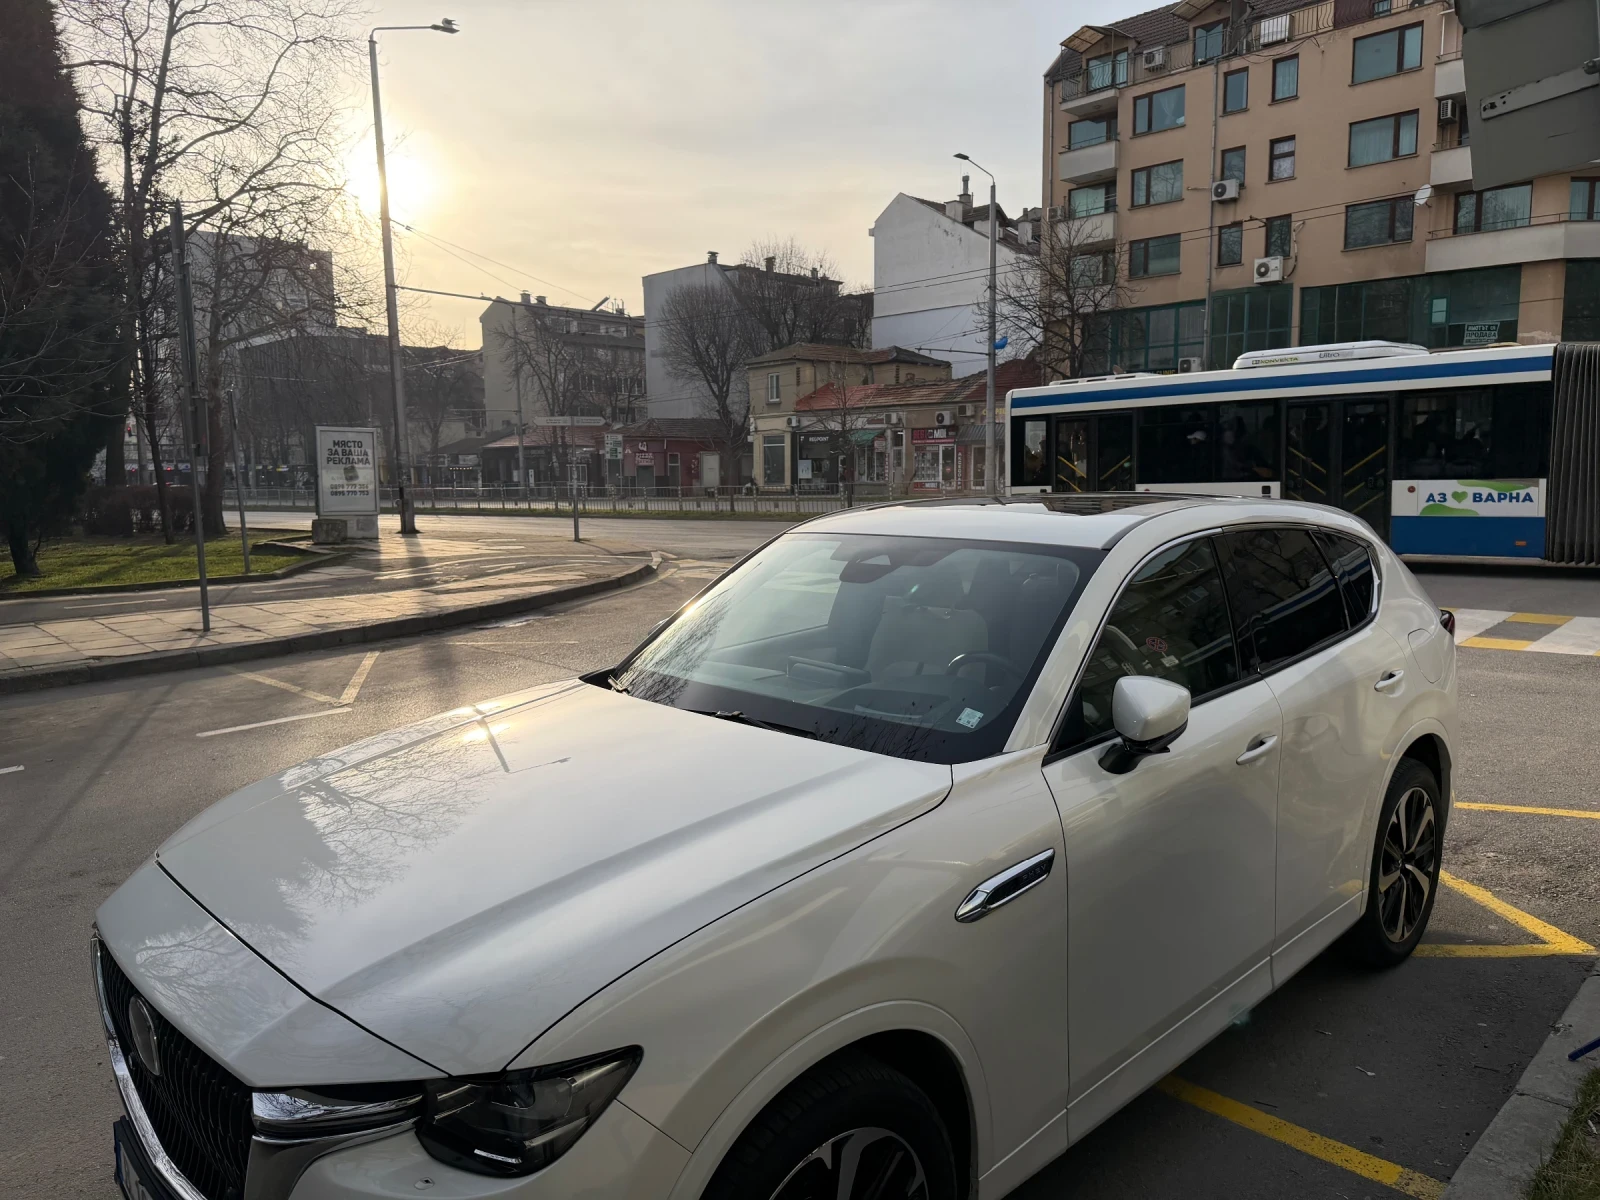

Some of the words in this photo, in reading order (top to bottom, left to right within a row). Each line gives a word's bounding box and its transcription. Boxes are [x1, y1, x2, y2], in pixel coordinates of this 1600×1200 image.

[332, 440, 363, 448] МЯСТО
[326, 457, 371, 465] РЕКЛАМА
[1425, 492, 1448, 503] АЗ
[1472, 492, 1534, 503] ВАРНА
